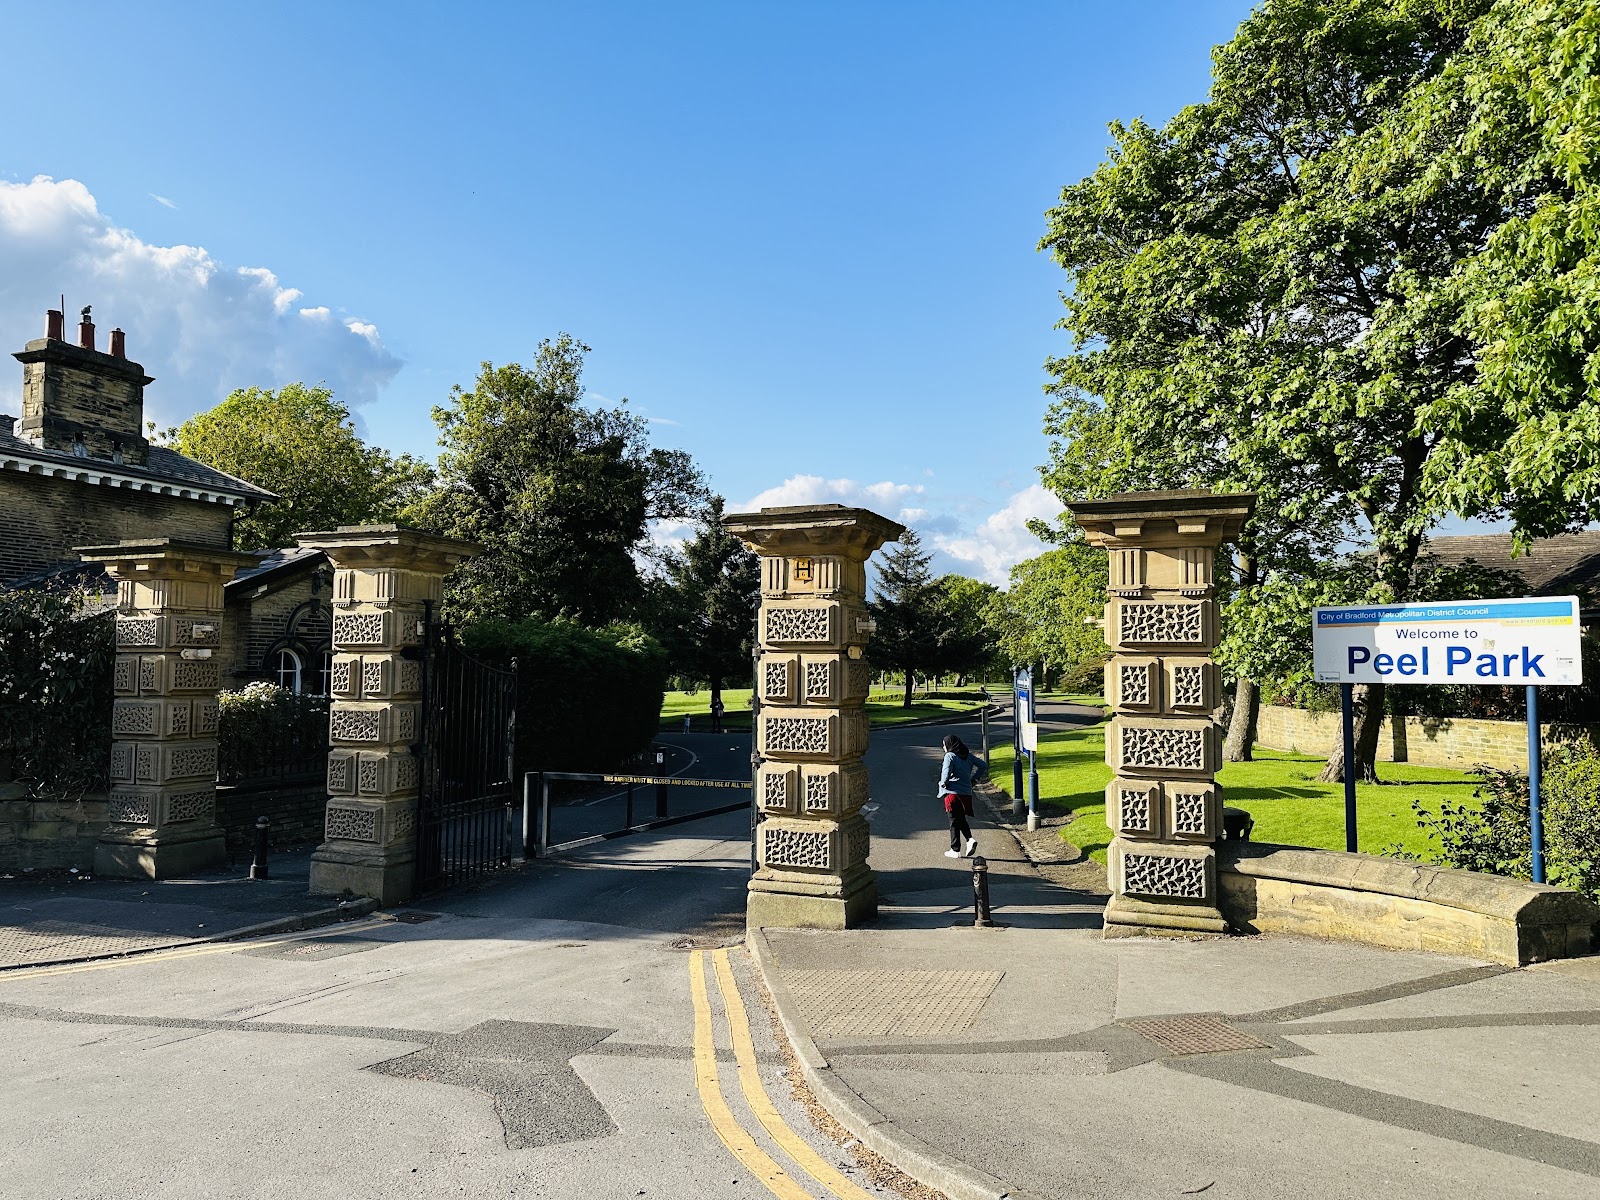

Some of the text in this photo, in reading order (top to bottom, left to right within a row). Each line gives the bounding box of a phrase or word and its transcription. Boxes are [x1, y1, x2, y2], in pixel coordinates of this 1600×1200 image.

[1320, 607, 1489, 621] City of Bradford Metropolitan District Council
[1395, 628, 1478, 639] Welcome to
[1347, 645, 1546, 678] Peel Park
